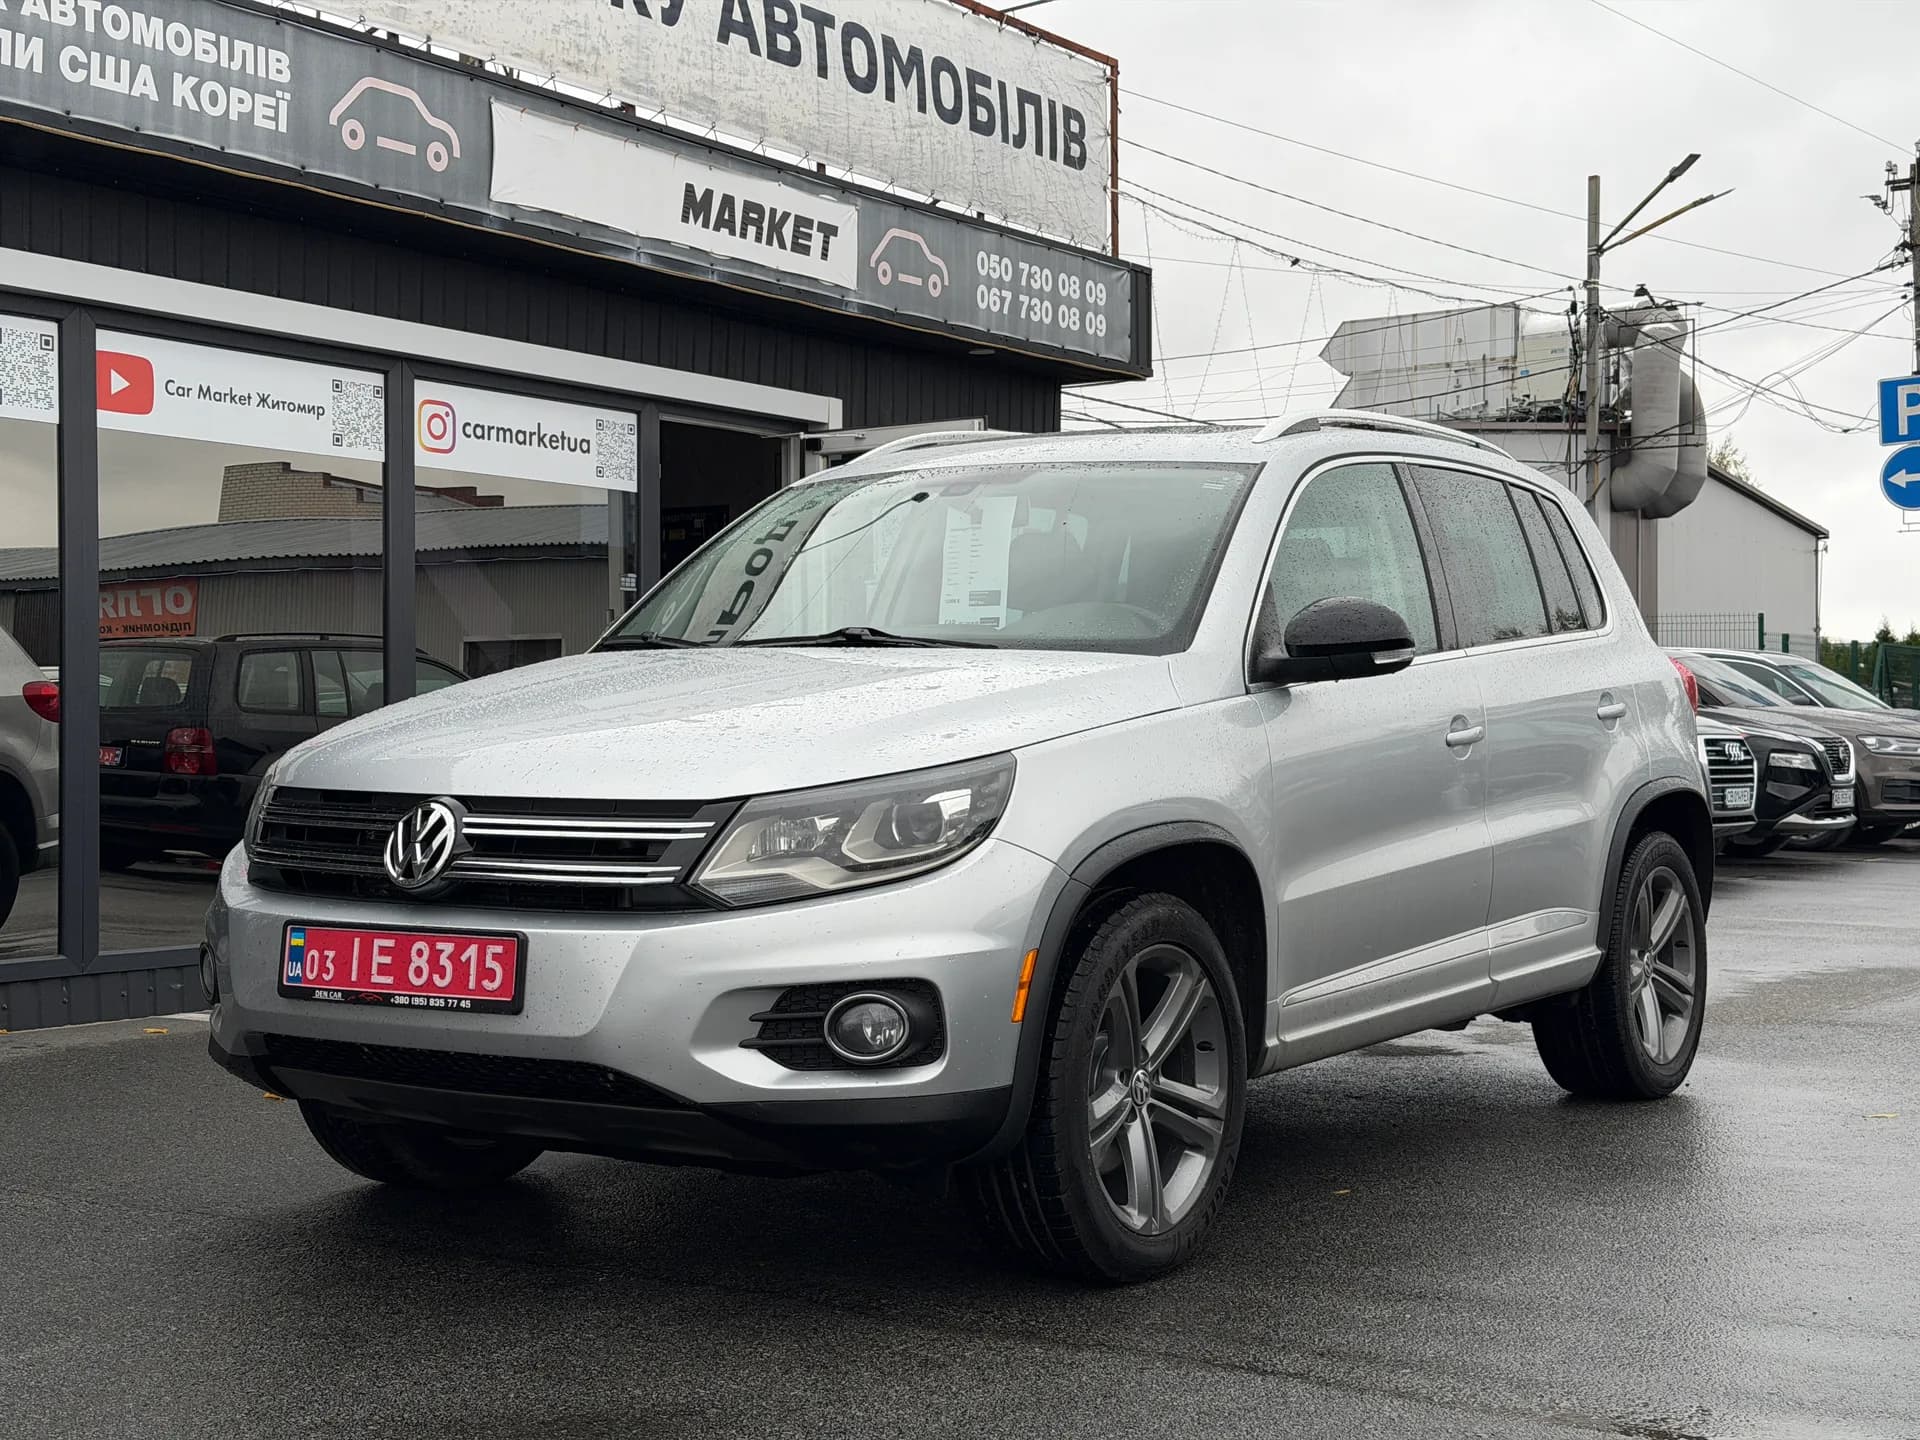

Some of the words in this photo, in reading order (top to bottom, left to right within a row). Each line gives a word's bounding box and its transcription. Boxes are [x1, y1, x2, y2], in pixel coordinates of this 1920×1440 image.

[20, 0, 292, 83] АВТОМОБІЛІВ
[59, 45, 159, 101] США
[172, 72, 291, 133] КОРЕЇ
[716, 0, 1088, 171] АВТОМОБІЛІВ
[681, 182, 839, 261] MARKET
[977, 251, 1012, 282] 050
[1019, 262, 1052, 292] 730
[1058, 272, 1080, 299] 08
[1085, 280, 1106, 306] 09
[977, 284, 1012, 314] 067
[1019, 294, 1052, 324] 730
[1058, 304, 1080, 331] 08
[1085, 312, 1106, 337] 09
[164, 379, 192, 400] Car
[198, 382, 252, 407] Market
[256, 393, 326, 419] Житомир
[1897, 384, 1920, 435] P
[462, 419, 591, 455] carmarketua
[288, 961, 302, 977] UA
[305, 949, 336, 981] 03
[408, 941, 504, 991] 8315
[315, 990, 328, 998] DEN
[390, 996, 409, 1004] +380
[447, 999, 458, 1008] 77
[460, 1000, 471, 1008] 45
